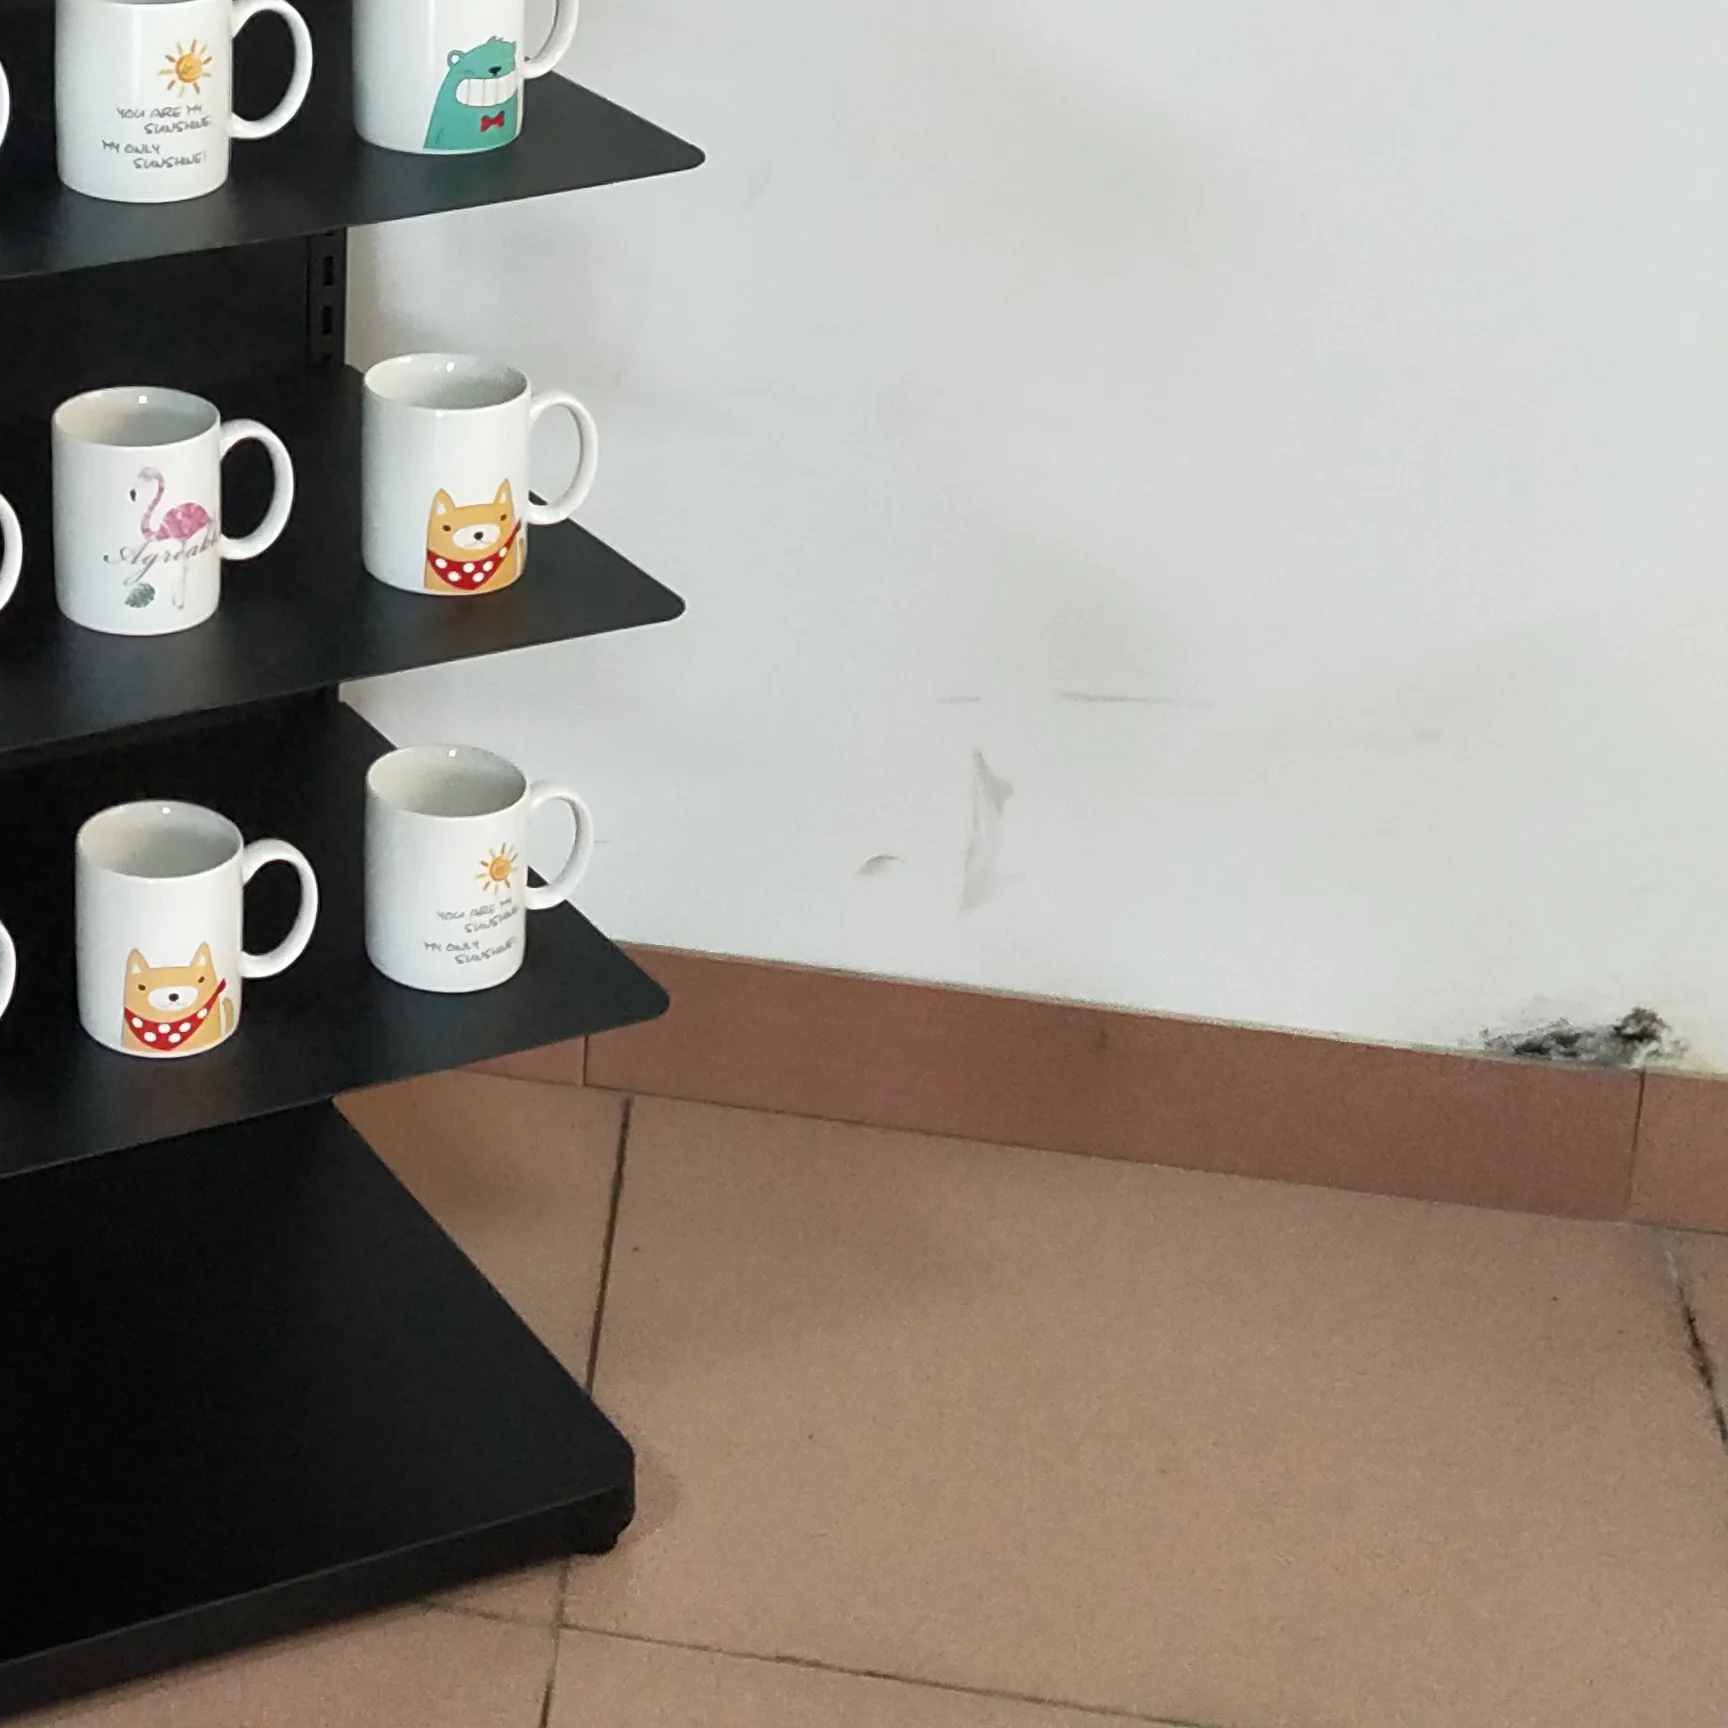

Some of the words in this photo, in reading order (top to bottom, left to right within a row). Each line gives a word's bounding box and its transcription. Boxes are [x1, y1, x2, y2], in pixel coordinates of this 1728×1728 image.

[116, 106, 145, 120] YOU
[149, 105, 182, 119] ARE
[186, 103, 204, 115] MY
[101, 139, 120, 154] MY
[124, 143, 161, 156] ONLY
